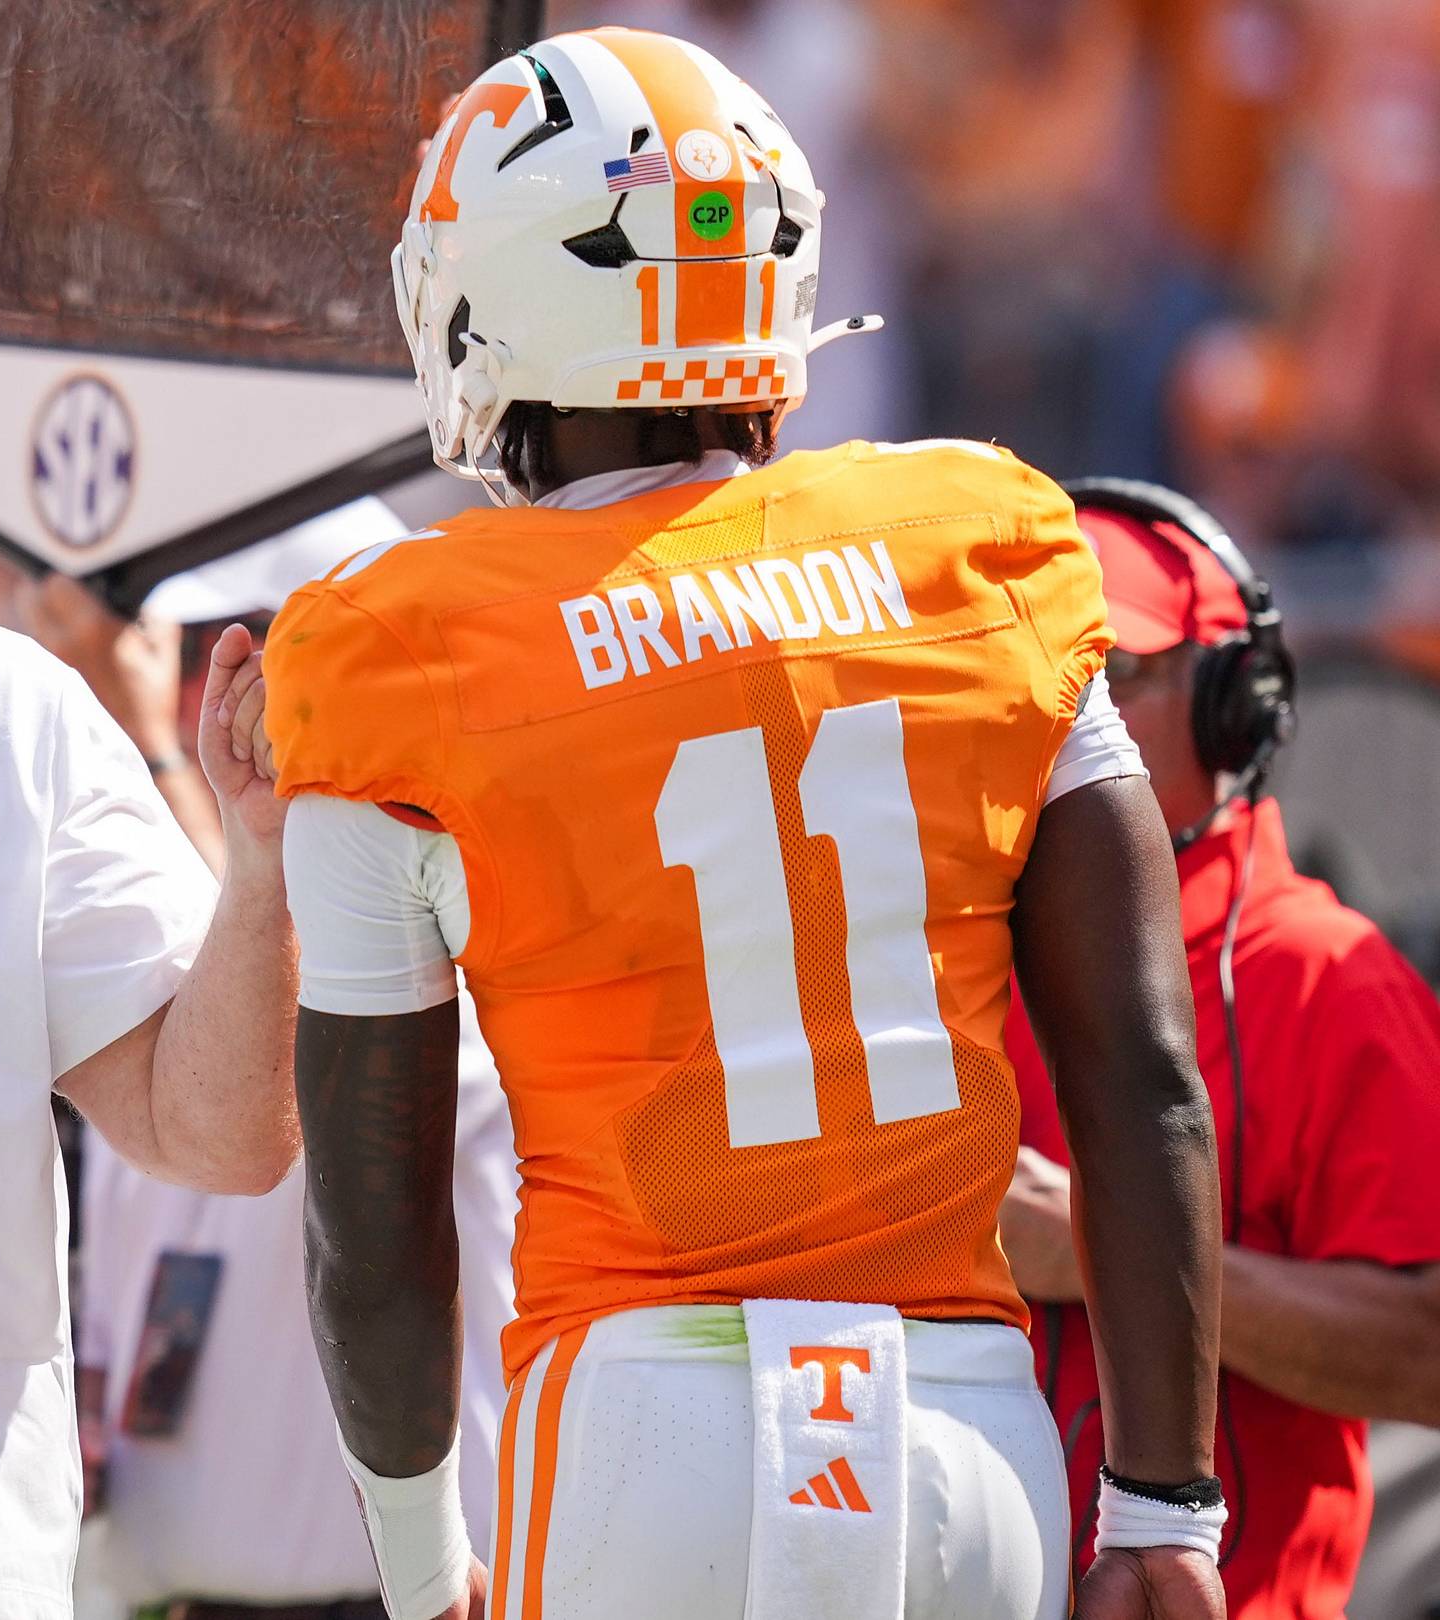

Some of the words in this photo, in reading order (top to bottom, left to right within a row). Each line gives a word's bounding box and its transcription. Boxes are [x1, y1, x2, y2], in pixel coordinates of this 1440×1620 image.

[692, 206, 730, 225] C2P
[559, 540, 913, 691] BRANDON
[653, 697, 962, 1149] 11
[789, 1345, 871, 1423] T
